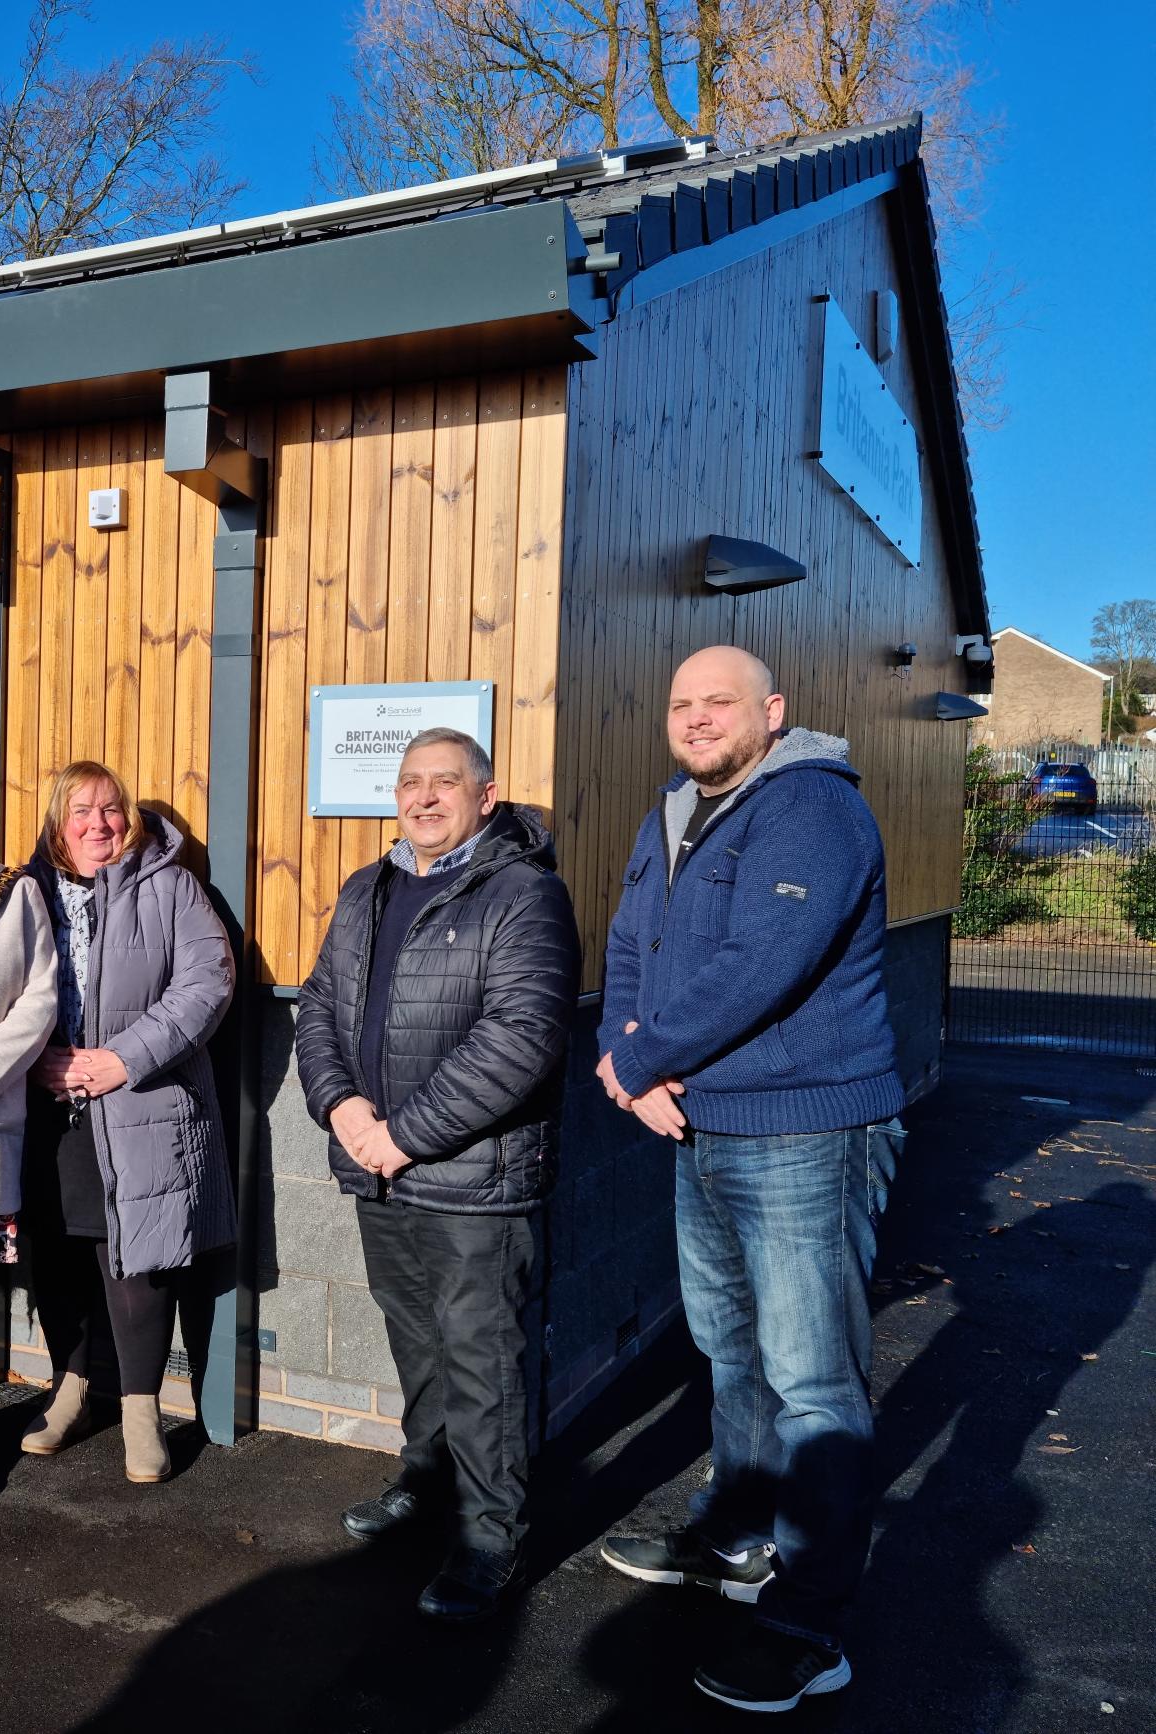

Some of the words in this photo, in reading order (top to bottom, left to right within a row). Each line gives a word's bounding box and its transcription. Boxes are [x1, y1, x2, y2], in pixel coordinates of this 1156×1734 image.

[837, 362, 889, 490] Britannia
[346, 730, 413, 741] BRITANNIA
[335, 743, 406, 754] CHANGING
